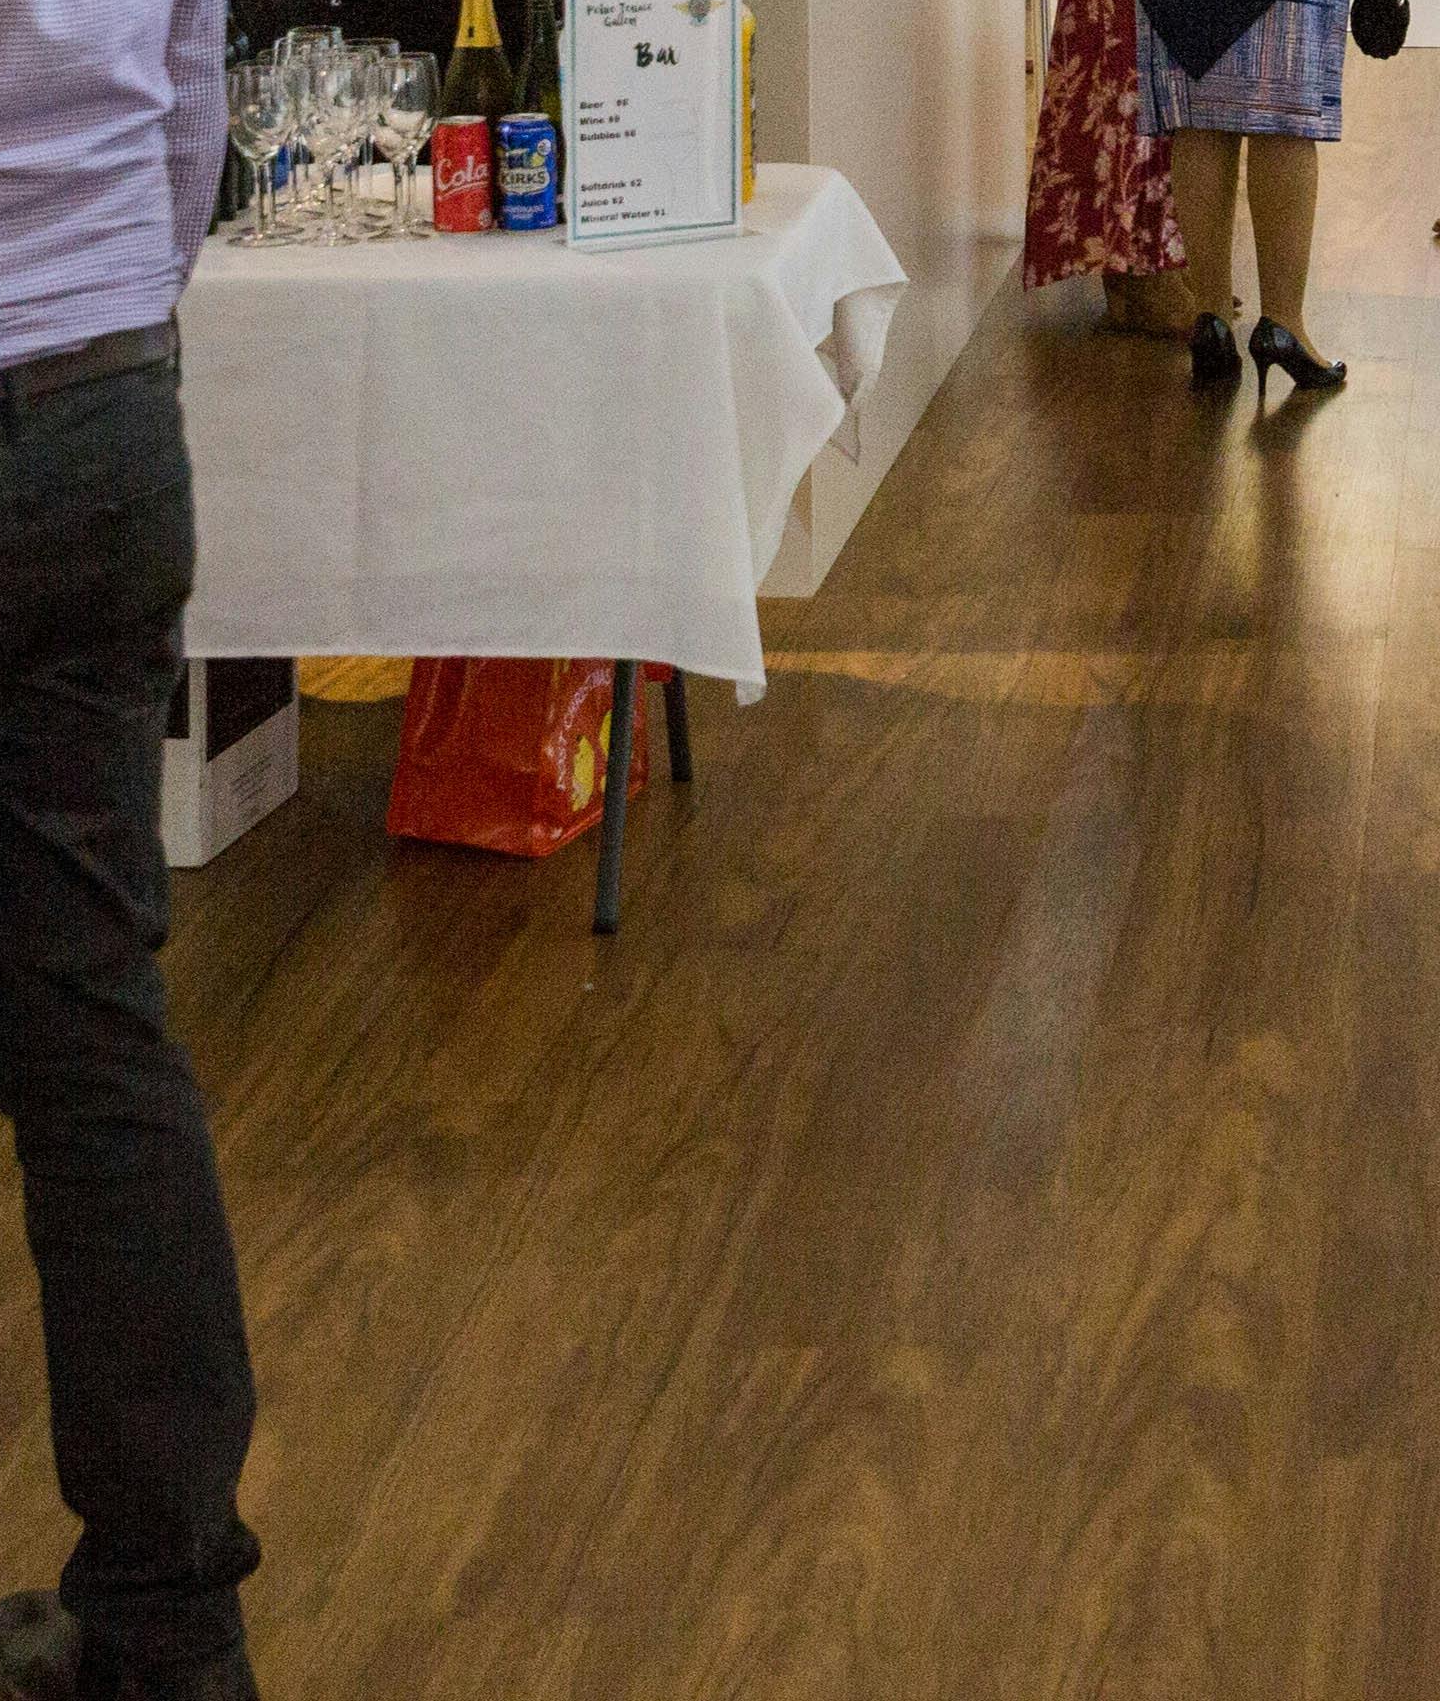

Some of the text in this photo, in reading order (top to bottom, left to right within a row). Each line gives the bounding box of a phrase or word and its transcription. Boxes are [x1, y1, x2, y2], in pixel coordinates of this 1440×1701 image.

[634, 42, 679, 68] Bar
[580, 101, 604, 110] Beer
[580, 117, 605, 126] Wine
[580, 131, 621, 142] Bubbles
[435, 155, 489, 192] Cola
[501, 170, 546, 185] KIRKS
[580, 199, 609, 208] Juice
[580, 212, 619, 224] Mineral
[621, 210, 651, 220] Water
